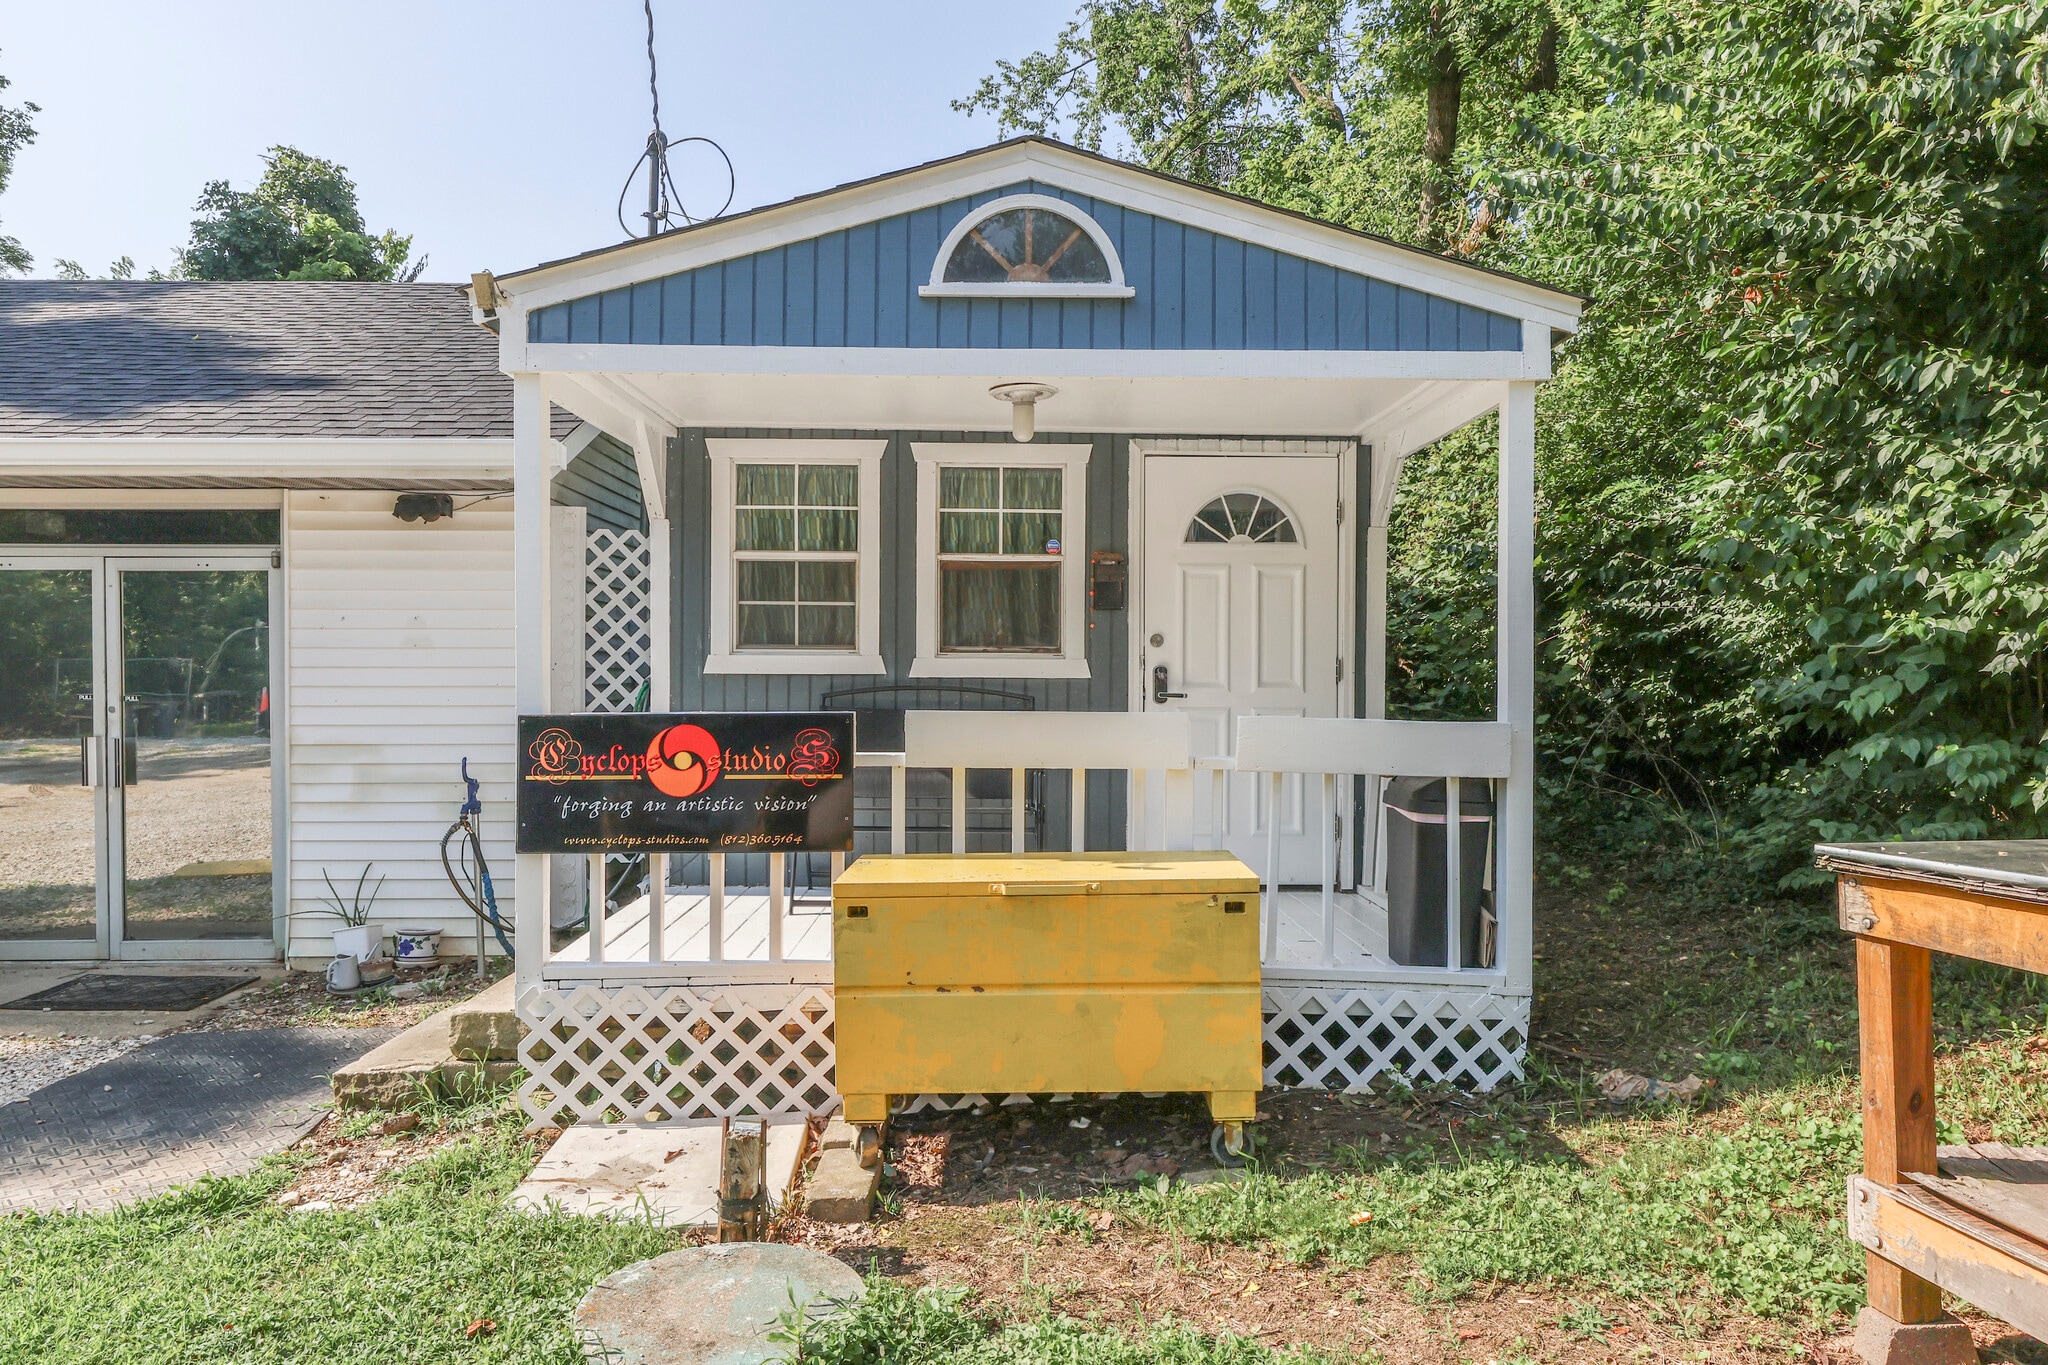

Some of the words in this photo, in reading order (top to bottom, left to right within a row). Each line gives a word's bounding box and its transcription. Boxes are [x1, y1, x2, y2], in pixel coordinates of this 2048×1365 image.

[528, 727, 662, 786] Cyclops
[643, 800, 667, 812] an
[676, 796, 744, 812] artistic
[564, 834, 709, 848] www.cyclops-studios.com
[720, 833, 803, 846] (812)360.5164
